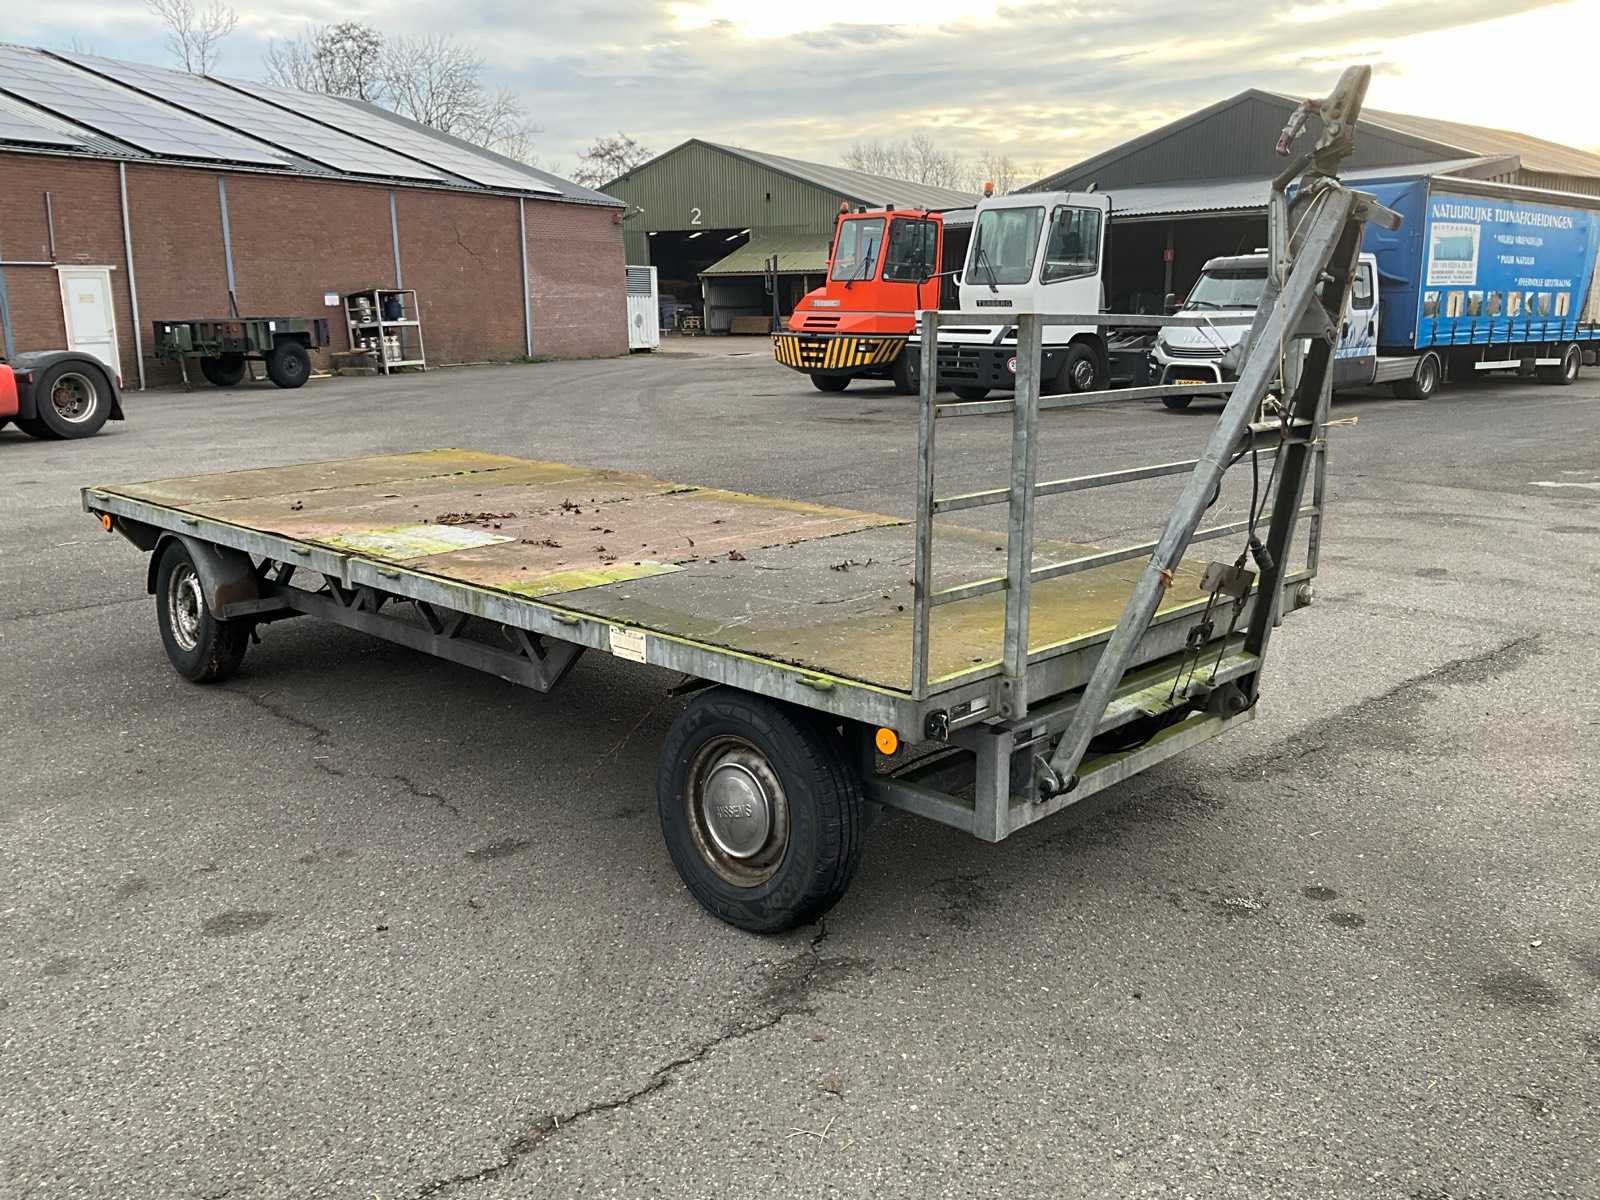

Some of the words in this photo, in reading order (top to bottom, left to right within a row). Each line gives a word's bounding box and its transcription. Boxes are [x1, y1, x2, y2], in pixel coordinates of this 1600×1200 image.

[690, 207, 702, 225] 2
[1432, 204, 1493, 222] NATUURLIJKE
[1494, 208, 1573, 229] TUINAFSCHEIDINGEN
